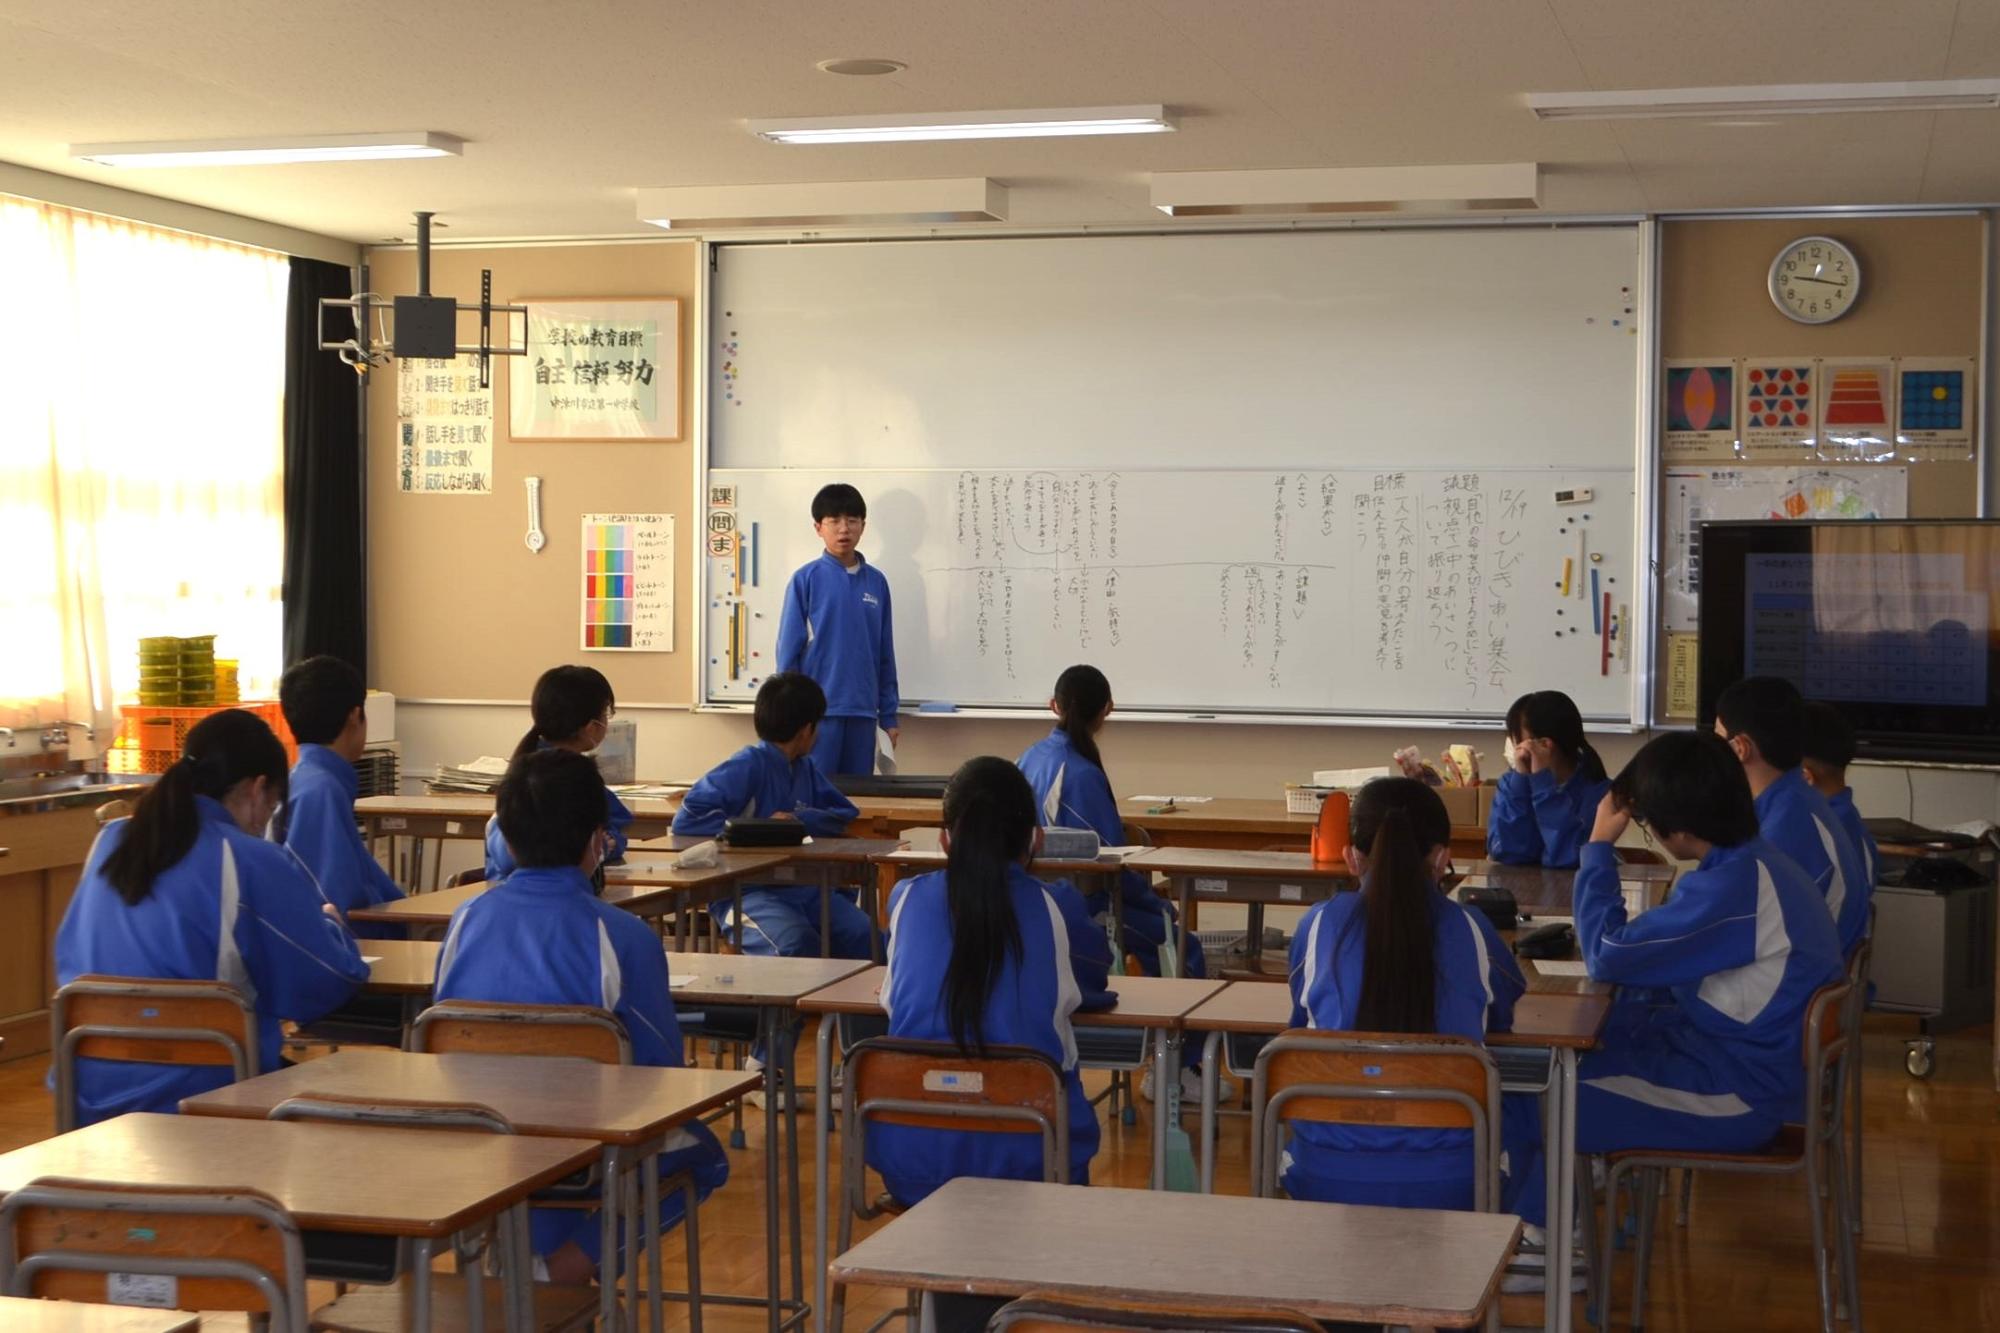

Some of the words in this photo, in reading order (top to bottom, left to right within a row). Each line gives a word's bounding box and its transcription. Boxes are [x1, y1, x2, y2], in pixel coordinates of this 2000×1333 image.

[1798, 251, 1806, 261] 11
[1811, 247, 1821, 258] 12
[1786, 261, 1797, 271] 10
[1836, 261, 1844, 271] 2
[1781, 275, 1788, 285] 9
[1841, 275, 1849, 286] 3
[1787, 289, 1795, 299] 8
[1835, 289, 1842, 299] 4
[1798, 299, 1804, 308] 7
[1810, 302, 1817, 313] 6
[1824, 298, 1832, 309] 5
[550, 328, 643, 347] 学校の教育目標
[535, 357, 566, 385] 自主
[573, 359, 609, 385] 信頼
[614, 358, 654, 386] 努力
[1374, 473, 1406, 492] 目標
[711, 487, 732, 505] 課
[711, 514, 732, 532] 問
[710, 535, 732, 554] ま
